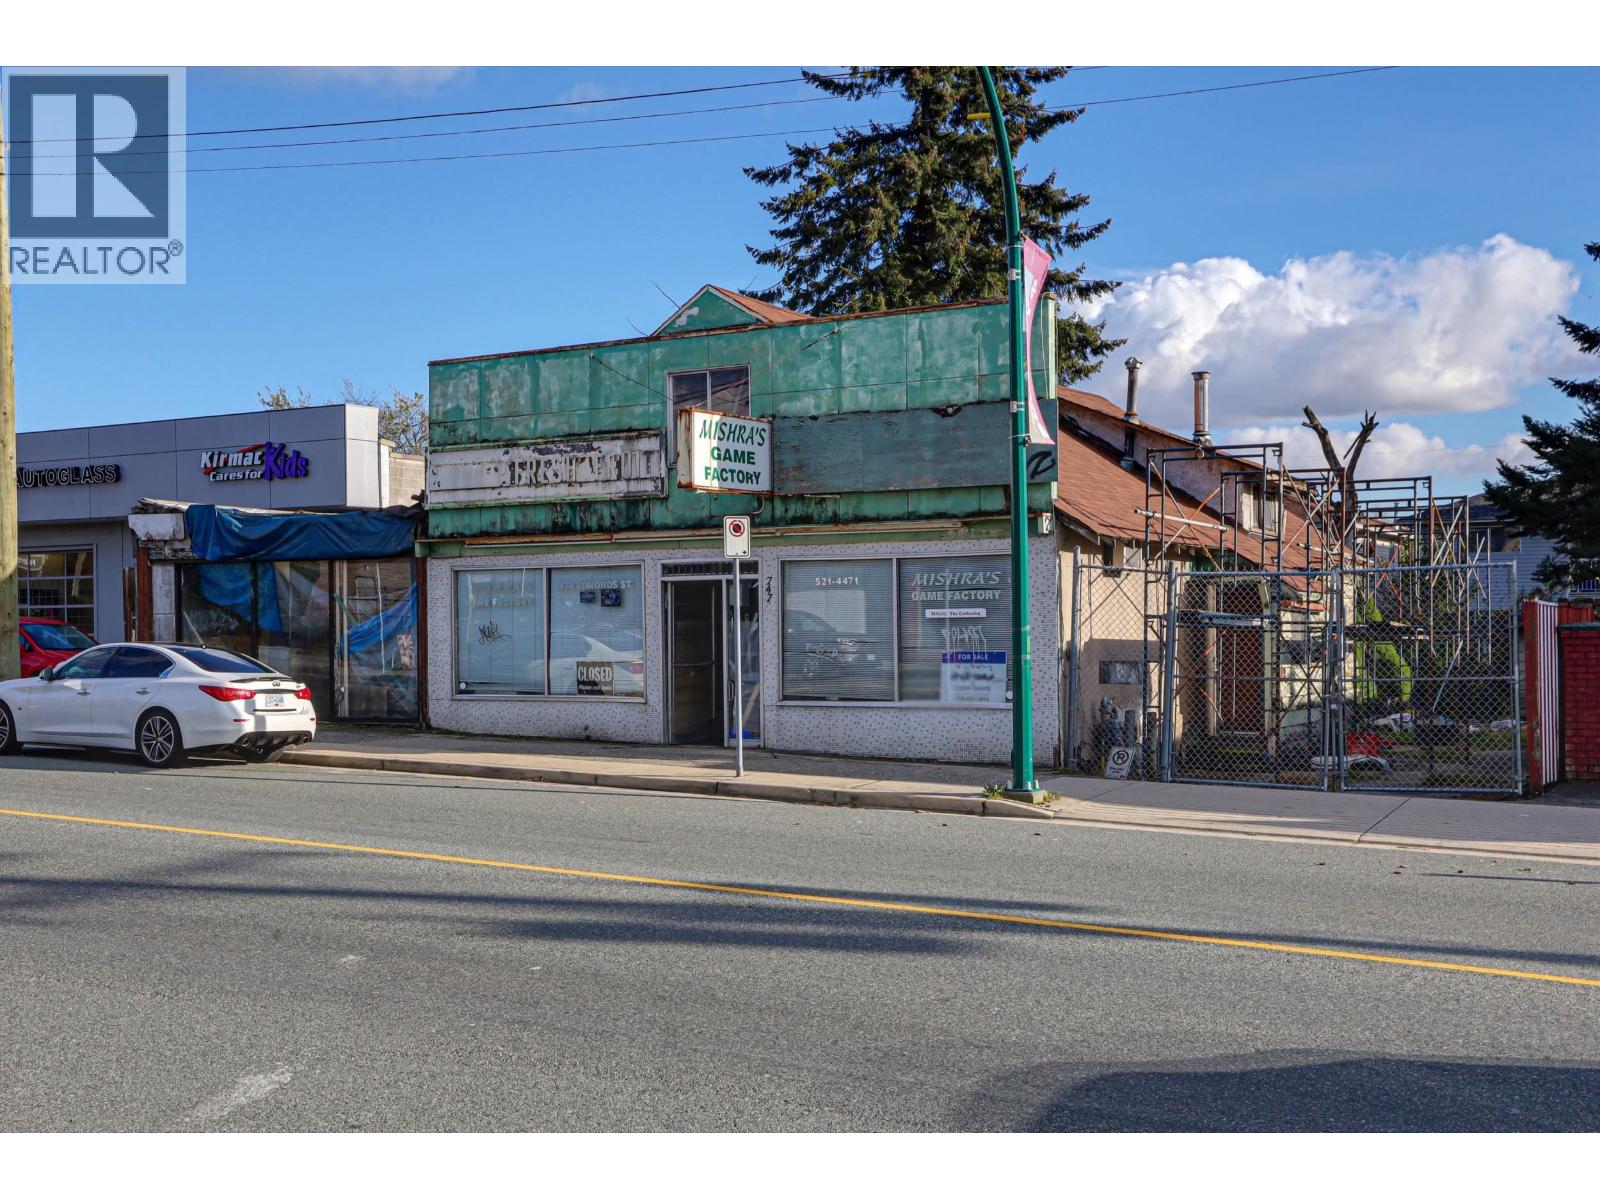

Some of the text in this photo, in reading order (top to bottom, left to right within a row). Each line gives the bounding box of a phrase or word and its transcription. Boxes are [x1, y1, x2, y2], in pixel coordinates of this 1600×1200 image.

[699, 419, 767, 447] MISHRA'S
[201, 451, 263, 469] Kirmac
[209, 442, 309, 482] Cares for Kids
[711, 446, 756, 466] GAME
[704, 466, 762, 485] FACTORY
[815, 576, 859, 586] 521-4471
[911, 571, 1002, 586] MISHRA'S
[765, 576, 774, 603] 747
[911, 589, 1001, 601] GAME FACTORY
[958, 653, 989, 661] FOR SALE
[577, 666, 613, 682] CLOSED
